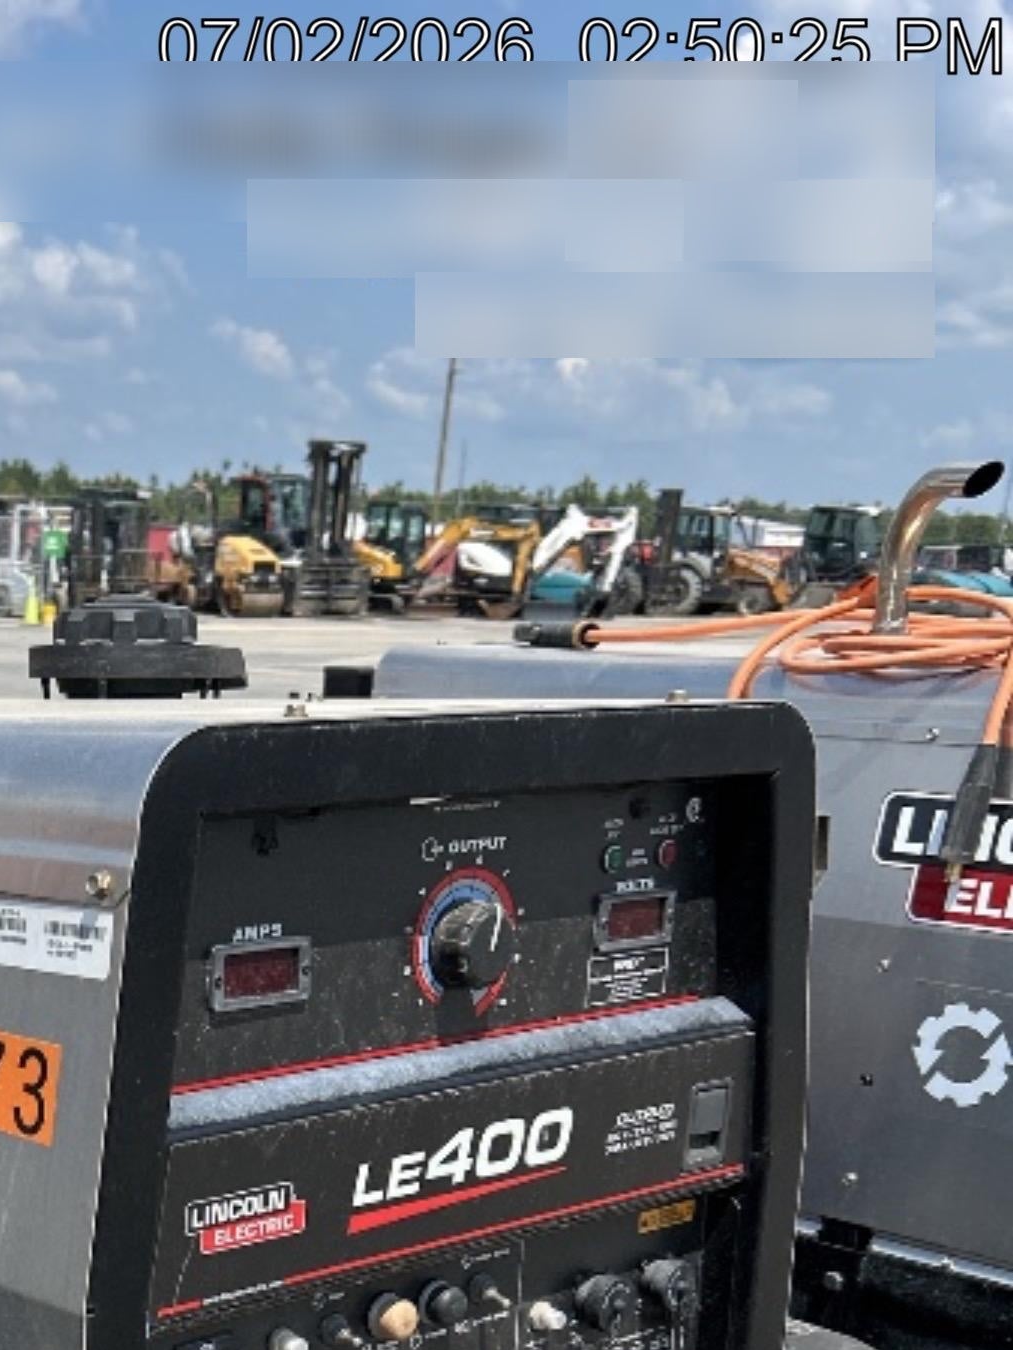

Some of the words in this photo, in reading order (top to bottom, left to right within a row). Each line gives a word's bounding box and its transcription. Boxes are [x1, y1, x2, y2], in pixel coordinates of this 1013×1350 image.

[448, 835, 508, 854] OUTPUT
[232, 922, 283, 944] AMPS
[352, 1105, 574, 1208] LE400
[191, 1187, 286, 1229] LINCOLN
[213, 1213, 295, 1247] ELECTRIC
